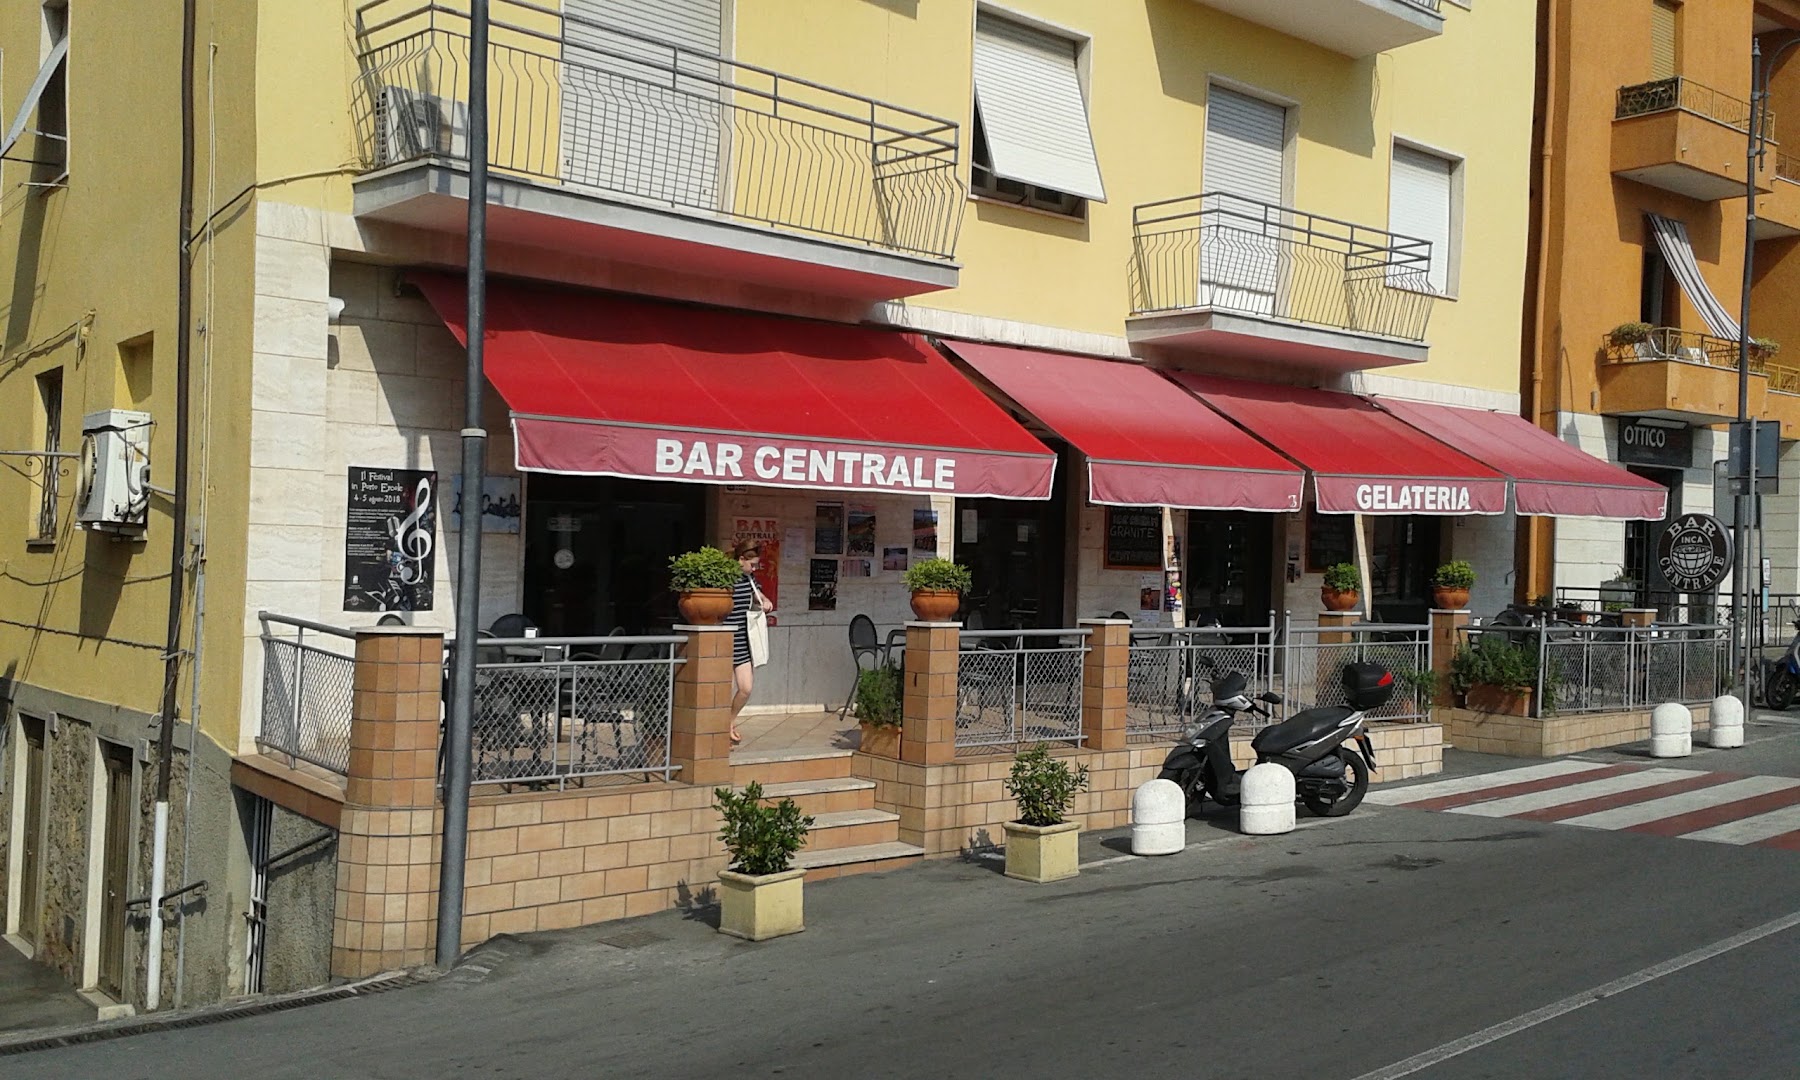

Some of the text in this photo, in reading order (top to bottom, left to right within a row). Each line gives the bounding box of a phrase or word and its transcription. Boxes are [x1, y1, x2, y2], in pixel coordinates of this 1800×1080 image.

[1624, 425, 1666, 448] OTTICO
[656, 438, 956, 490] BAR CENTRALE
[369, 471, 393, 481] Festival
[351, 482, 403, 493] in Porto Ercole
[384, 495, 401, 503] 2018
[1356, 484, 1471, 510] GELATERIA
[736, 519, 777, 532] BAR
[1109, 526, 1155, 538] GRANITE
[1666, 516, 1717, 538] BAR
[1681, 535, 1703, 543] INCA
[1660, 556, 1725, 590] CENTRALE
